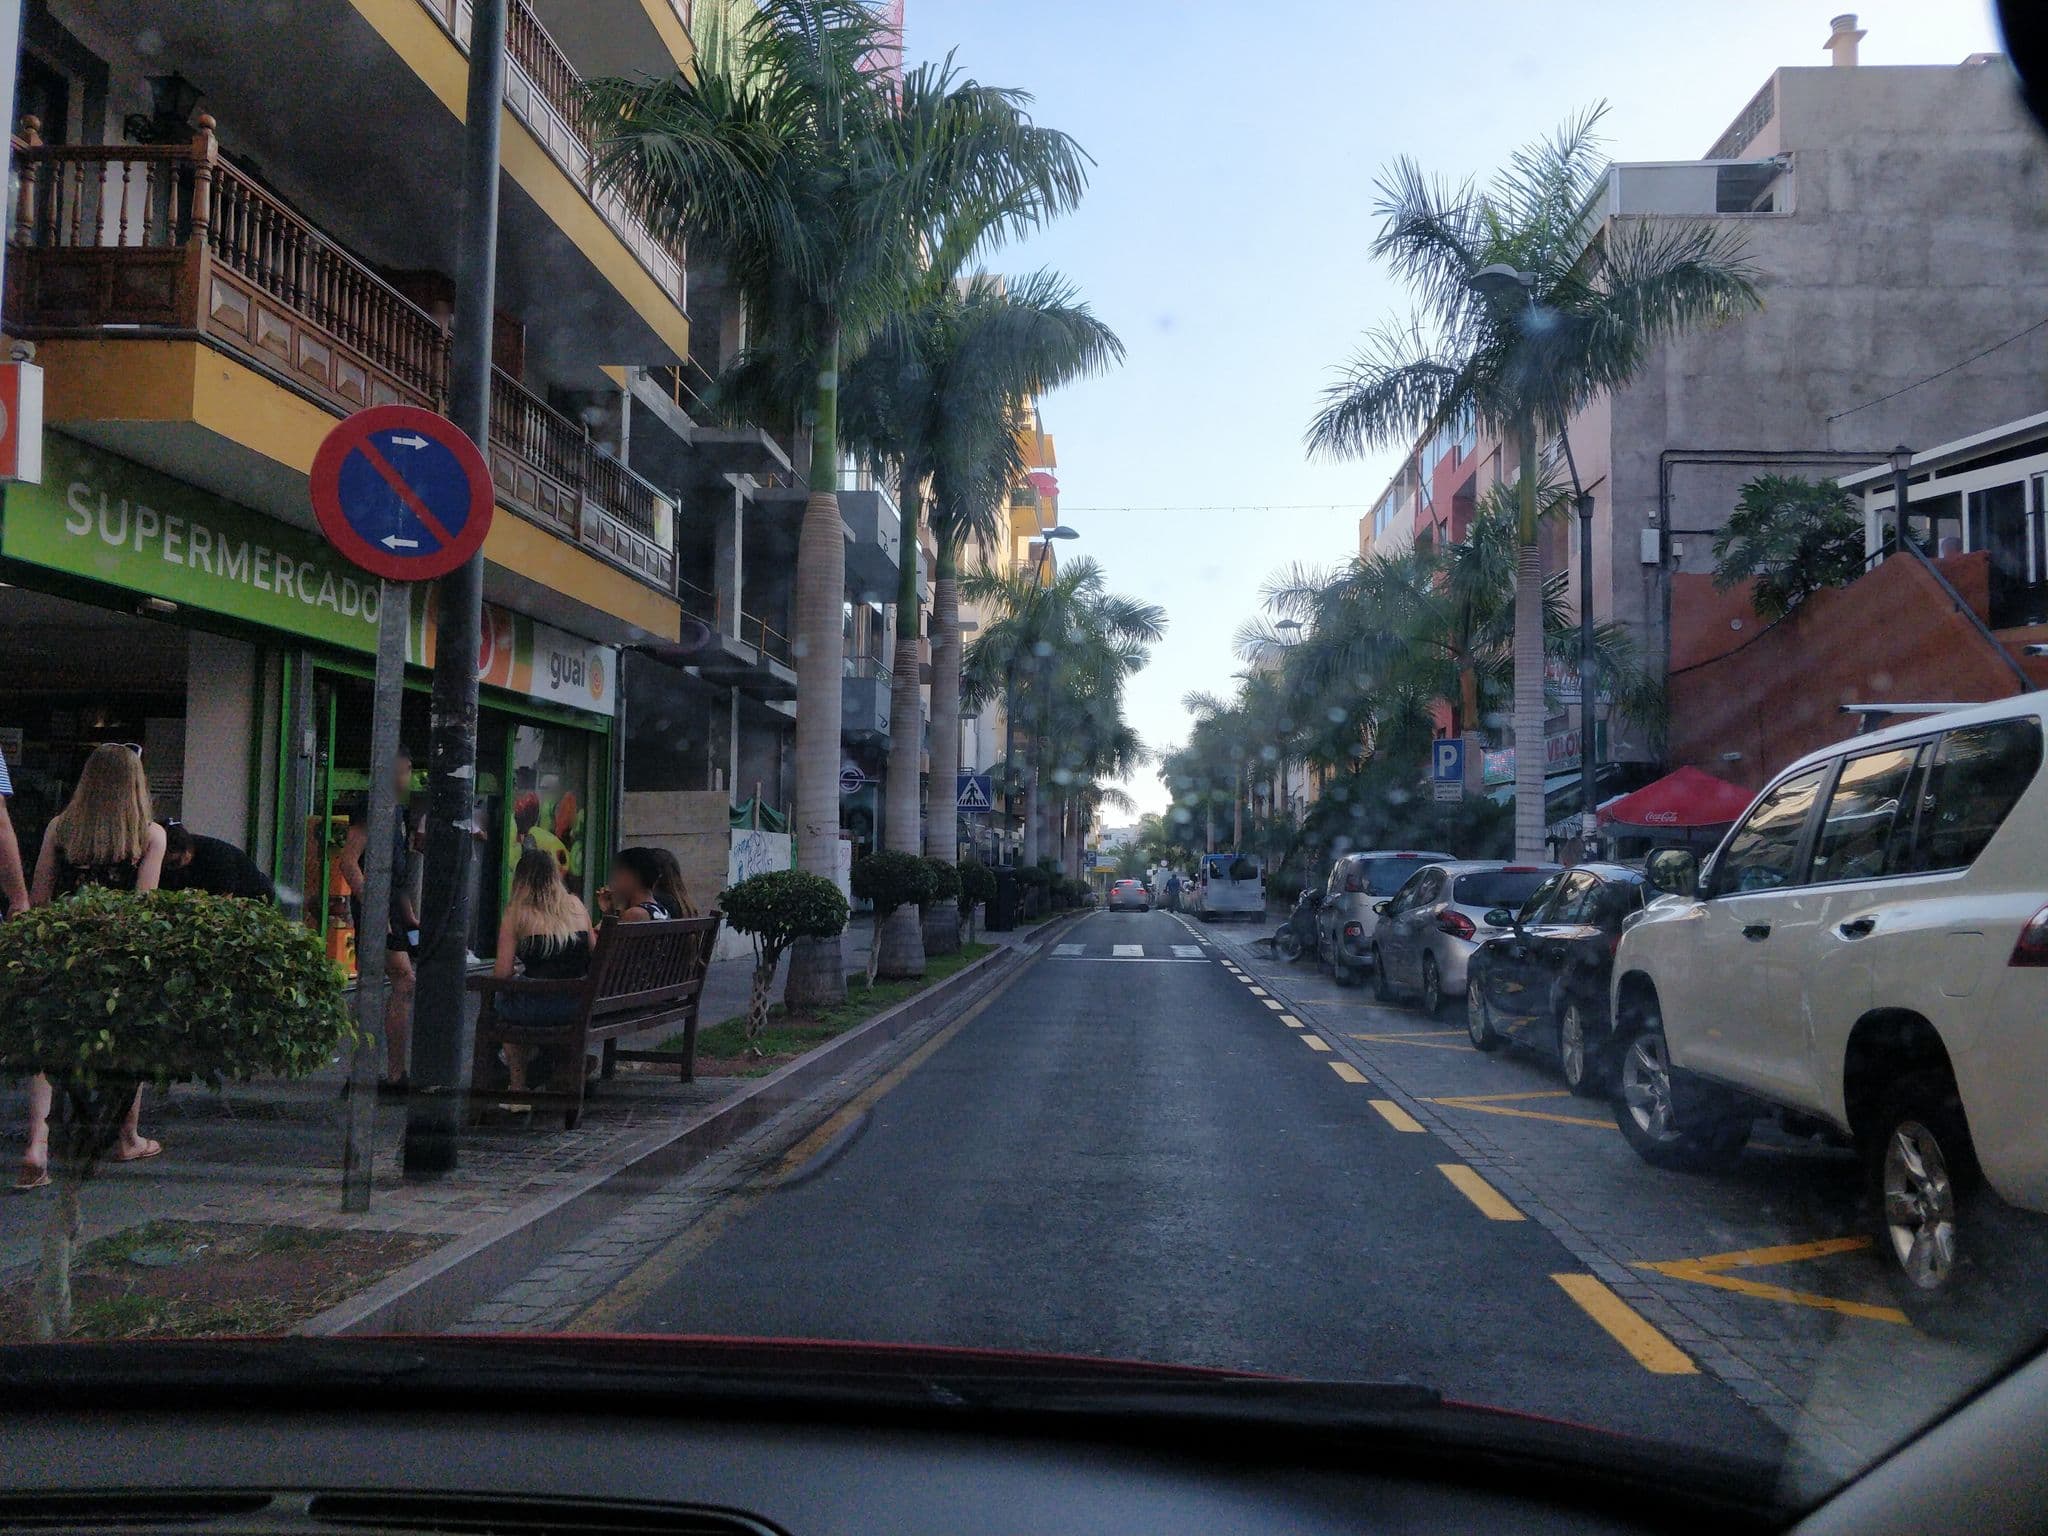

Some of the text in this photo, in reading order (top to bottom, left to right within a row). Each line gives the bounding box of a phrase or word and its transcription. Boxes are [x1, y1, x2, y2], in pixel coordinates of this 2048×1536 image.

[66, 482, 381, 624] SUPERMERCADO
[551, 651, 586, 690] guai
[1439, 745, 1457, 777] P
